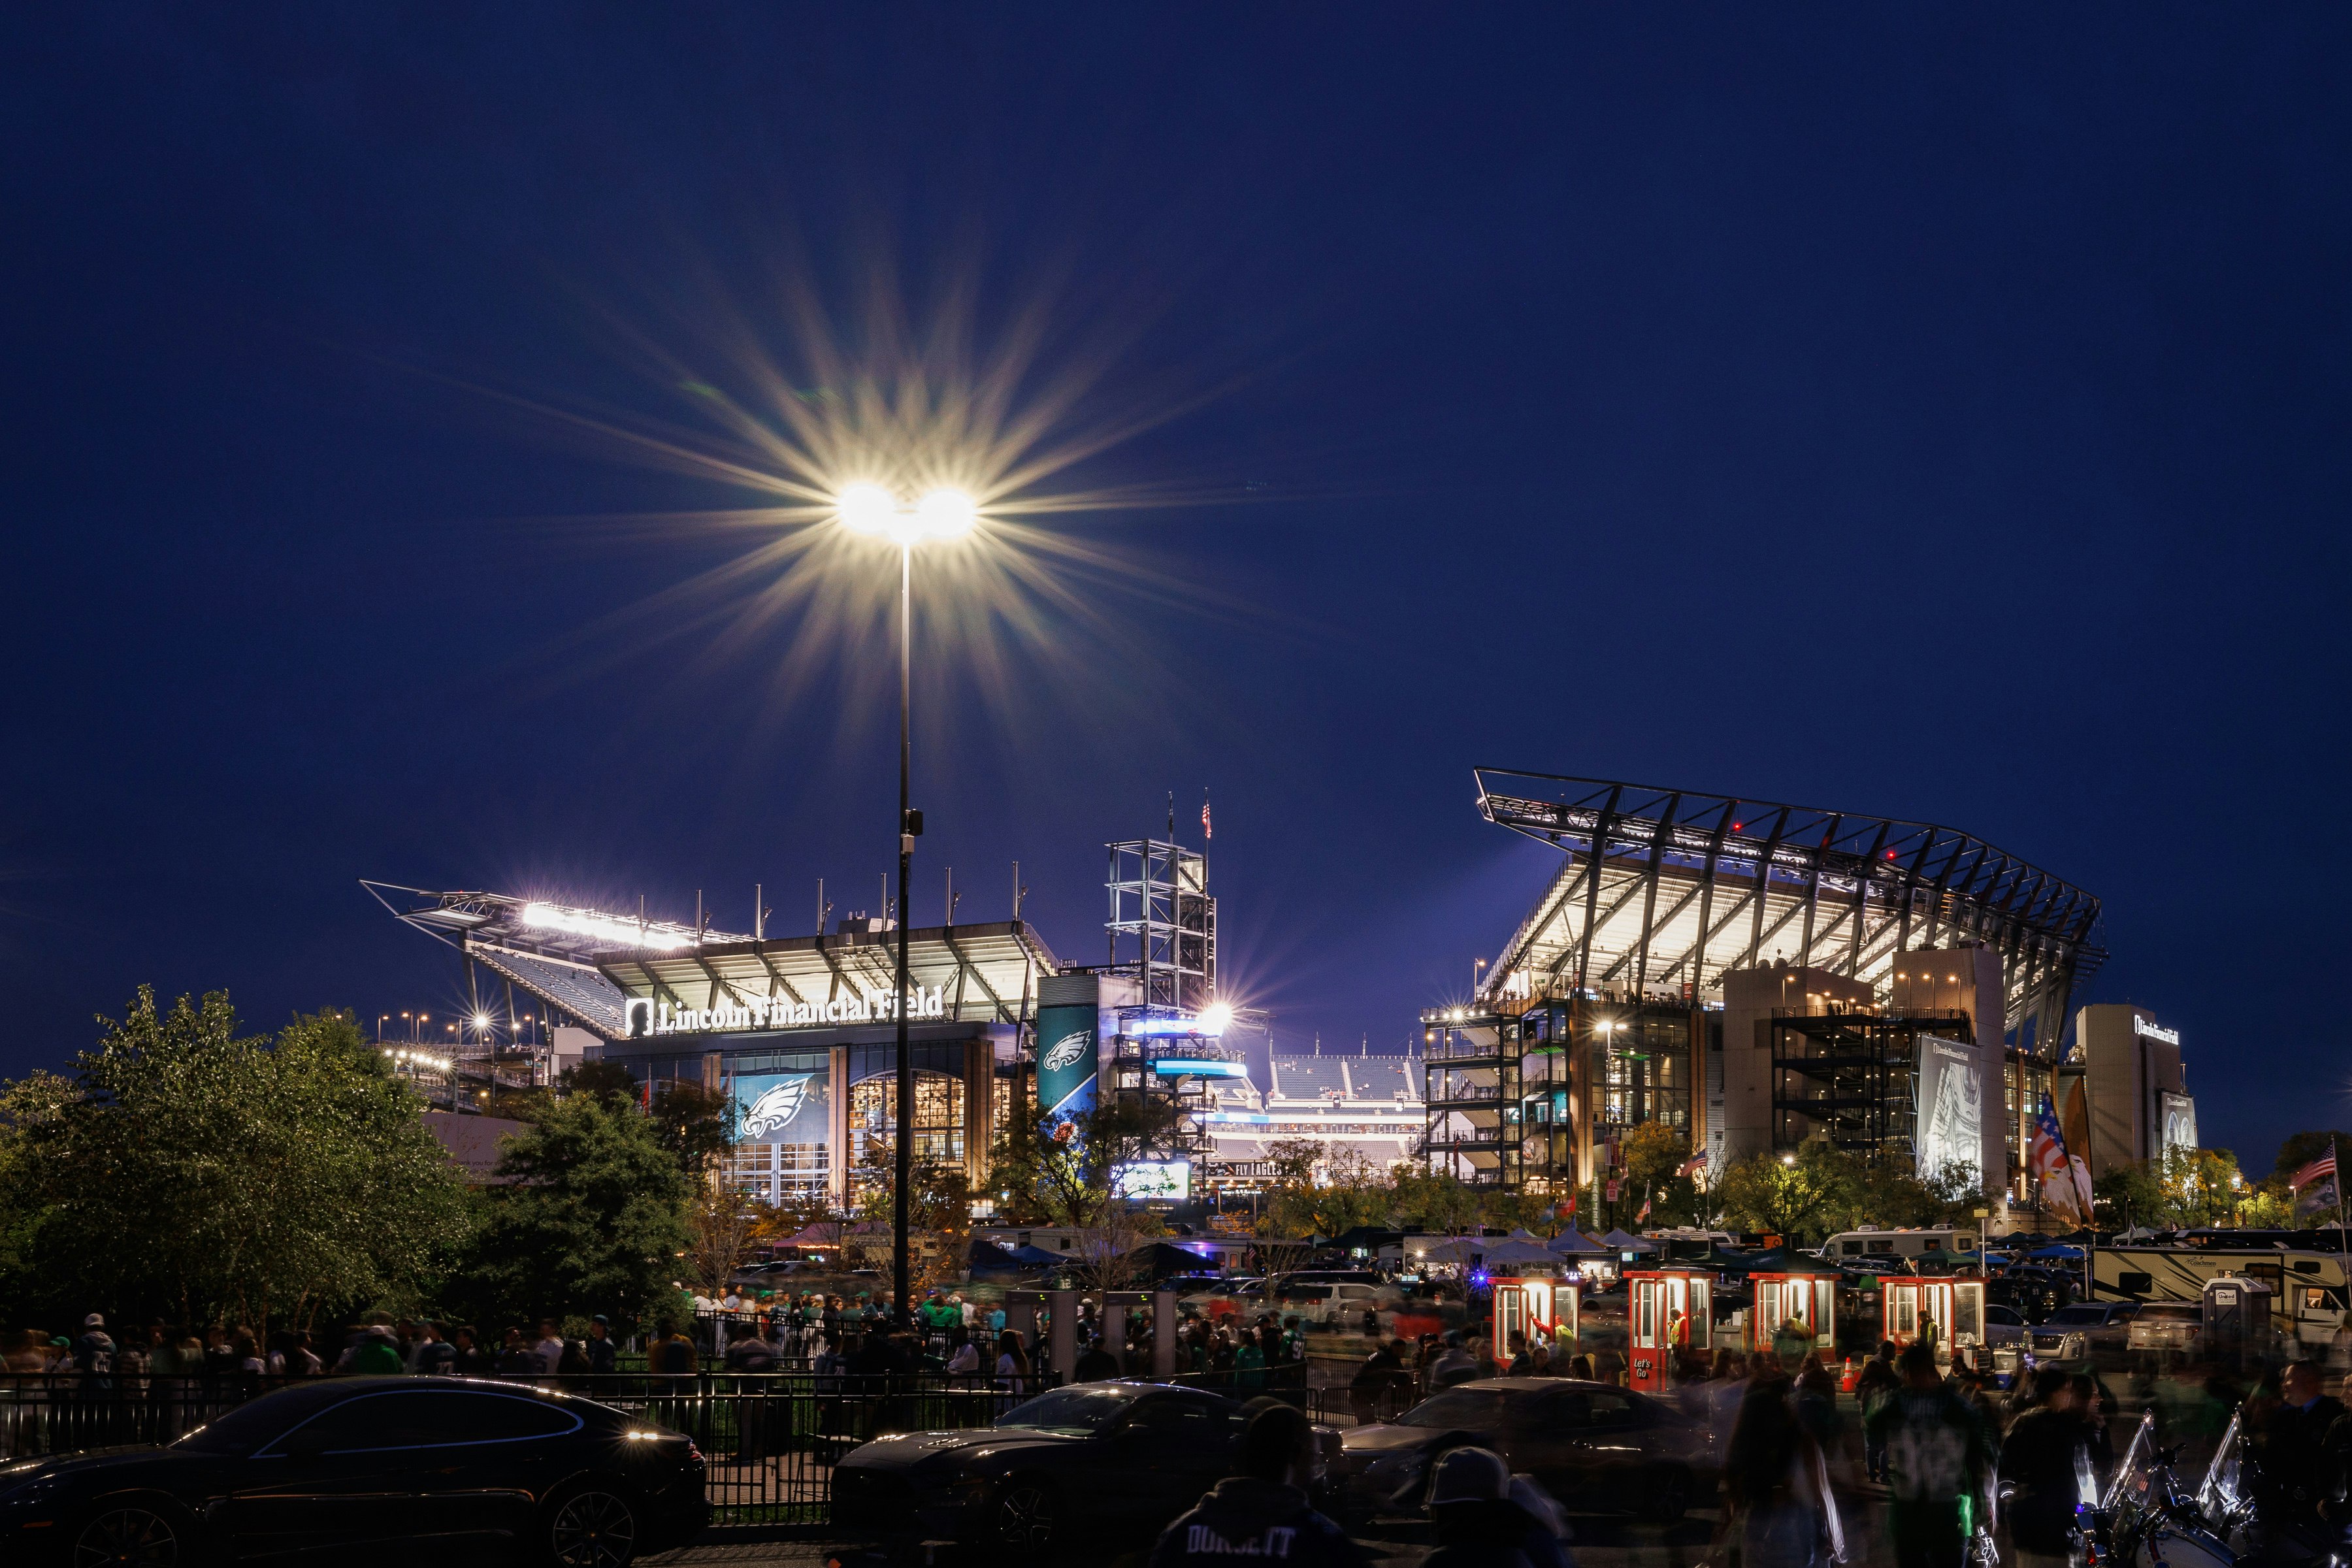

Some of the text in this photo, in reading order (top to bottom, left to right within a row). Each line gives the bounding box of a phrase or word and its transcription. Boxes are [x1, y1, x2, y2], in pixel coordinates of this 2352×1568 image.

[657, 985, 943, 1032] Lincoln Financial Field
[1235, 1164, 1248, 1176] FLY
[1251, 1162, 1282, 1176] EAGLES
[1633, 1358, 1651, 1368] Let's
[1636, 1368, 1646, 1378] Go
